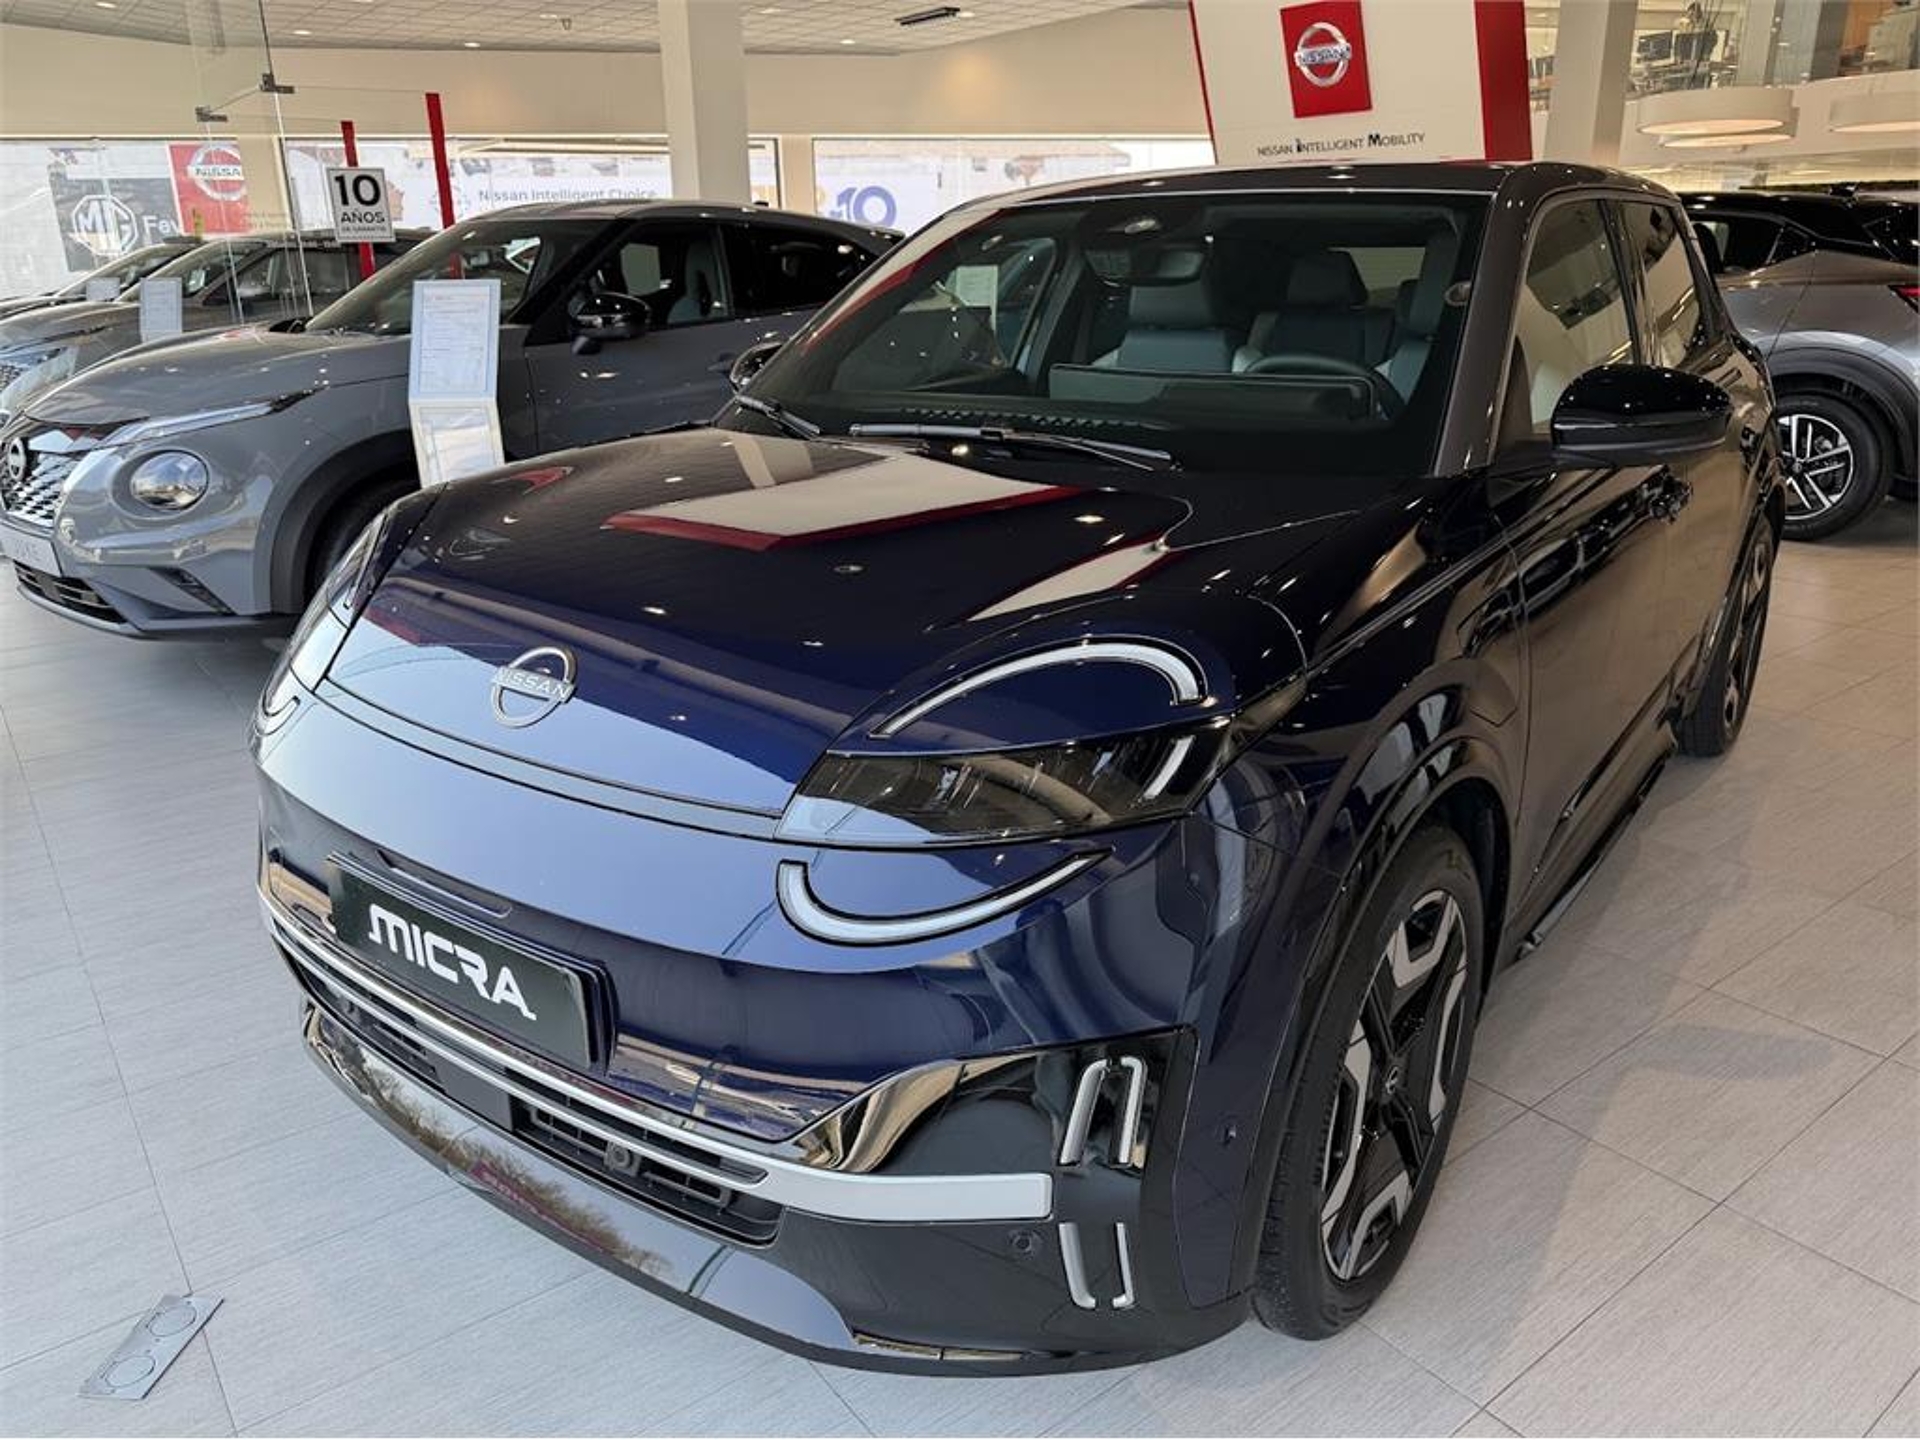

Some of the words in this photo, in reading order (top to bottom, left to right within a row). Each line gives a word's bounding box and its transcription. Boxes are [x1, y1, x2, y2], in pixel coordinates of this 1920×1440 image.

[1257, 144, 1292, 157] NISSAN
[1296, 138, 1365, 153] INTELLIGENT
[1368, 133, 1425, 147] MOBILITY
[194, 167, 241, 177] NISSA
[334, 174, 381, 207] 10
[479, 189, 528, 202] Nissan
[532, 188, 604, 202] Intelligent
[76, 200, 131, 250] MG
[341, 208, 386, 224] AÑOS
[496, 666, 573, 704] NISSAN
[369, 903, 537, 1021] MICRA
